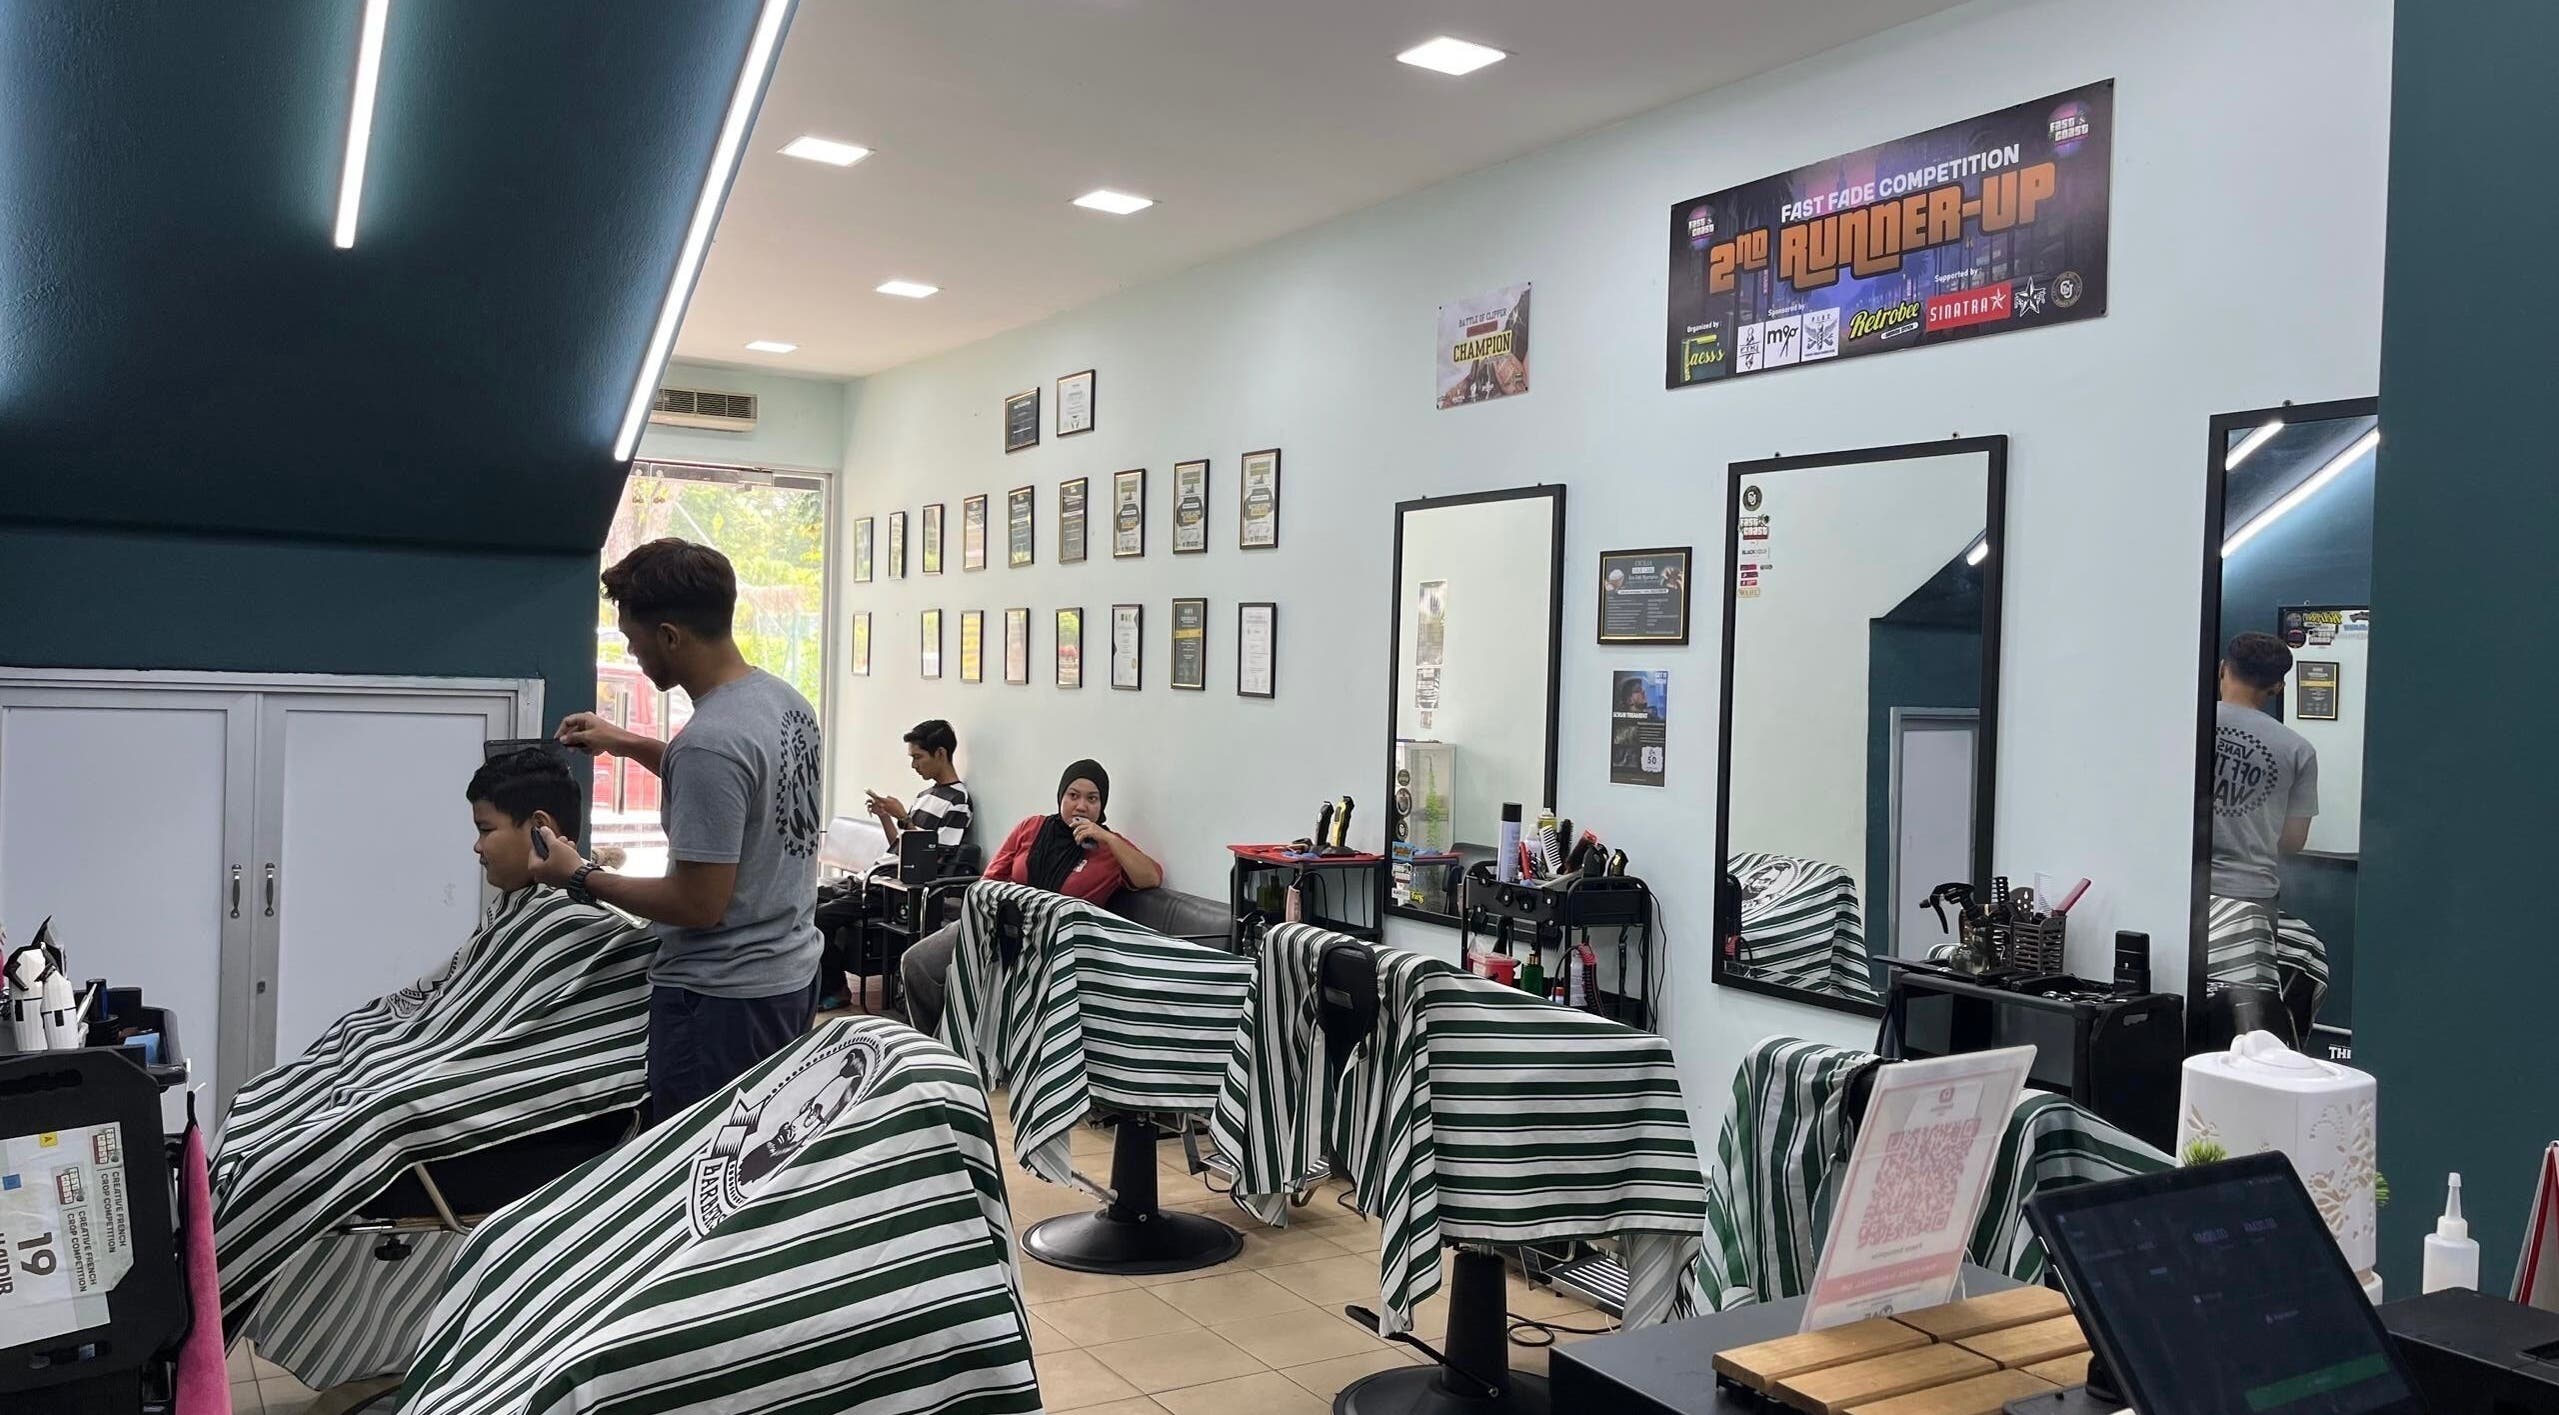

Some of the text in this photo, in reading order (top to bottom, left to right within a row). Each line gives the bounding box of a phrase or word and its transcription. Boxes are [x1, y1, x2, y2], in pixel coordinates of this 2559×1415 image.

[1780, 143, 2020, 224] FAST FADE COMPETITION
[1779, 162, 2056, 291] RUNNER-UP
[1453, 333, 1511, 363] CHAMPION
[1850, 301, 1920, 340] Retrobee
[1929, 299, 1988, 322] SINATRA
[101, 1173, 116, 1254] CROP COMPETITION
[112, 1171, 127, 1247] CREATIVE FRENCH
[17, 1231, 57, 1276] 19
[67, 1213, 87, 1292] CROP COMPETITION
[78, 1210, 97, 1285] CREATIVE FRENCH
